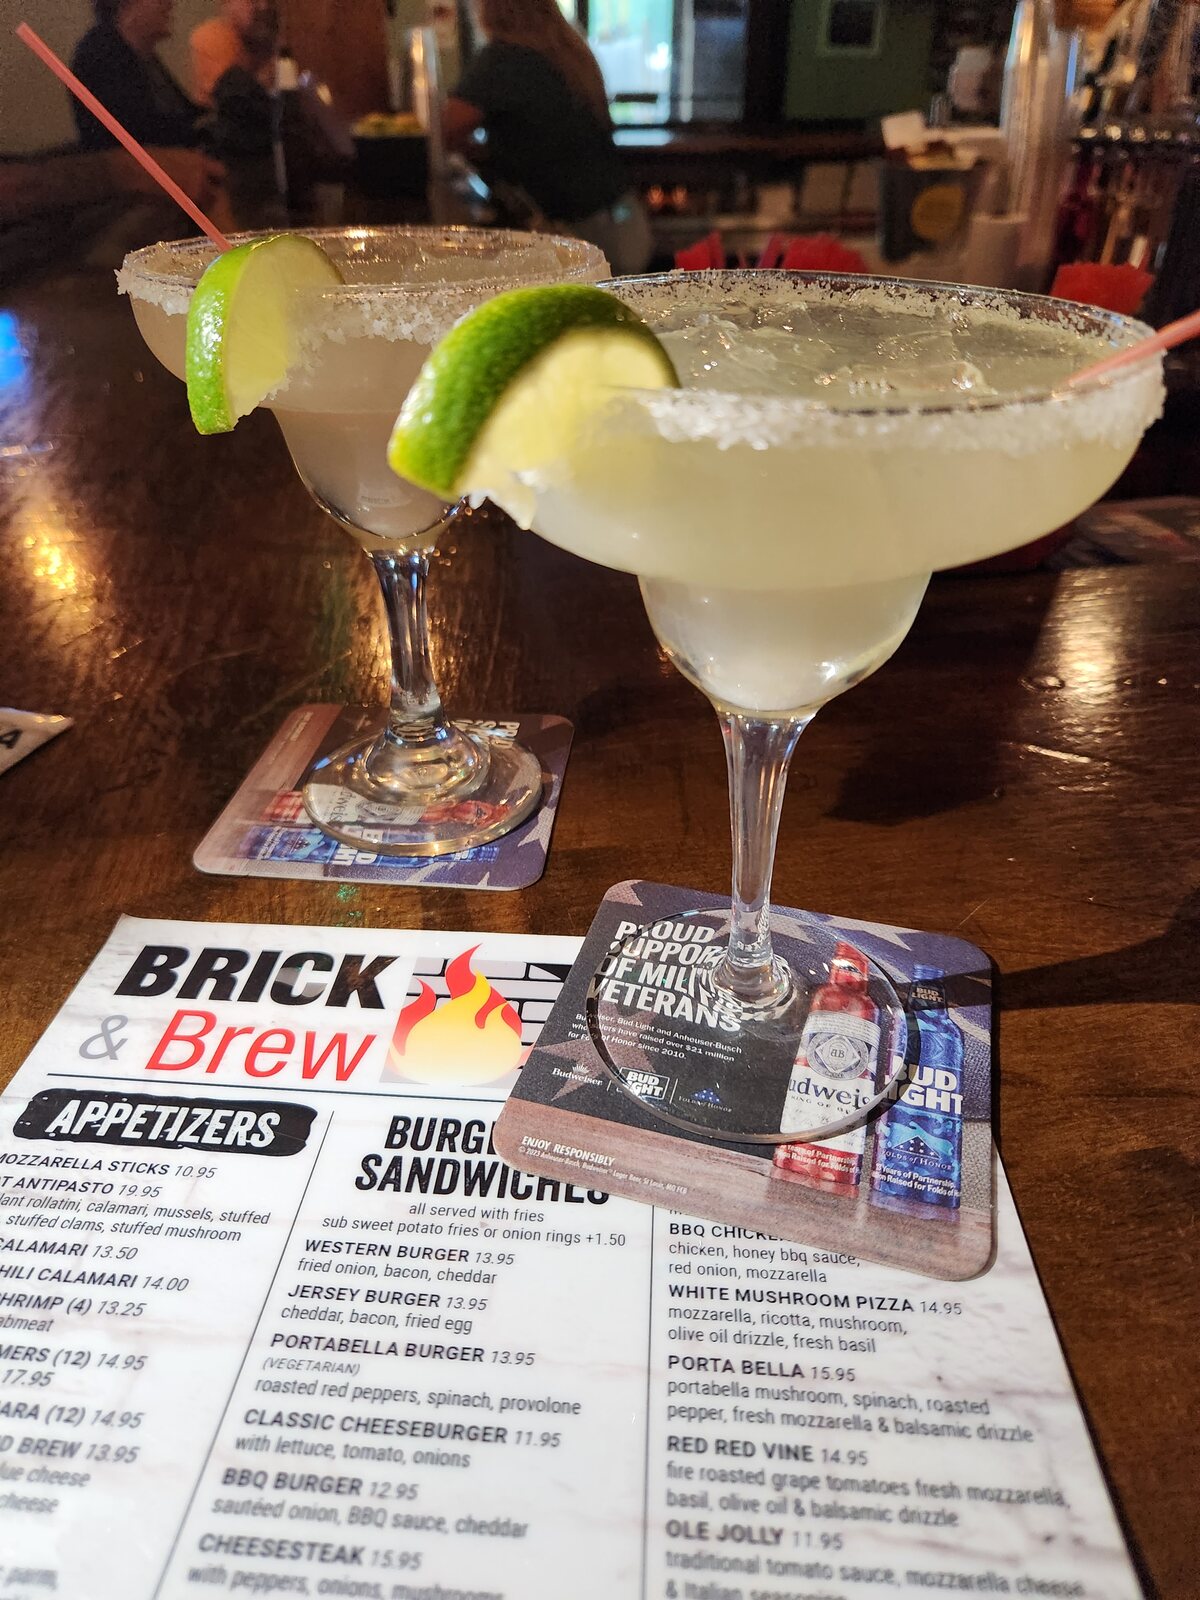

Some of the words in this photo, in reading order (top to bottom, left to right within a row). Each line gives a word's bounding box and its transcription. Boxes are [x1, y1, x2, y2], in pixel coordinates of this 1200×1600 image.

[114, 945, 400, 1009] BRICK
[917, 987, 939, 997] BUD
[78, 1014, 128, 1060] &
[145, 1009, 377, 1082] Brew
[568, 1031, 580, 1040] for
[611, 1035, 636, 1047] Honor
[637, 1043, 660, 1053] since
[661, 1048, 687, 1060] 2010.
[617, 1017, 634, 1027] Bud
[635, 1020, 655, 1032] Light
[656, 1027, 672, 1037] and
[673, 1032, 742, 1054] Anheuser-Busch
[618, 1027, 638, 1038] have
[639, 1032, 665, 1045] raised
[666, 1039, 684, 1049] over
[685, 1045, 703, 1055] $21
[704, 1049, 735, 1062] million
[552, 1067, 603, 1086] Budweiser
[626, 1071, 660, 1086] BUD
[45, 1100, 282, 1148] APPETIZERS
[522, 1136, 551, 1151] ENJOY
[553, 1143, 616, 1166] RESPONSIBLY
[0, 1153, 103, 1171] MOZZARELLA
[108, 1161, 170, 1176] STICKS
[174, 1165, 218, 1179] 10.95
[12, 1177, 114, 1195] ANTIPASTO
[118, 1184, 163, 1198] 19.95
[26, 1195, 82, 1213] rollatini,
[86, 1201, 149, 1218] calamari,
[153, 1206, 214, 1222] mussels,
[219, 1211, 271, 1225] stuffed
[409, 1202, 426, 1216] all
[429, 1204, 476, 1218] served
[480, 1206, 511, 1220] with
[513, 1208, 545, 1222] fries
[5, 1213, 60, 1229] stuffed
[60, 1217, 105, 1234] clams,
[110, 1220, 163, 1237] stuffed
[164, 1224, 242, 1242] mushroom
[322, 1216, 348, 1229] sub
[351, 1219, 394, 1232] sweet
[397, 1220, 444, 1236] potato
[447, 1223, 479, 1238] fries
[483, 1227, 498, 1239] or
[502, 1226, 542, 1241] onion
[545, 1229, 581, 1246] rings
[585, 1232, 627, 1247] +1.50
[669, 1223, 706, 1238] BBQ
[92, 1245, 139, 1260] 13.50
[304, 1239, 392, 1258] WESTERN
[396, 1245, 470, 1263] BURGER
[474, 1251, 515, 1265] 13.95
[668, 1242, 729, 1259] chicken,
[732, 1245, 778, 1263] honey
[780, 1248, 808, 1265] bbq
[812, 1251, 861, 1268] sauce,
[38, 1267, 138, 1288] CALAMARI
[142, 1275, 190, 1291] 14.00
[297, 1258, 331, 1273] fried
[334, 1260, 379, 1278] onion,
[383, 1263, 433, 1281] bacon,
[436, 1267, 497, 1284] cheddar
[668, 1261, 693, 1275] red
[696, 1262, 743, 1280] onion,
[746, 1265, 827, 1283] mozzarella
[66, 1297, 92, 1316] (4)
[97, 1300, 148, 1318] 13.25
[288, 1284, 361, 1303] JERSEY
[364, 1289, 442, 1308] BURGER
[445, 1297, 488, 1312] 13.95
[668, 1284, 730, 1301] WHITE
[735, 1288, 851, 1309] MUSHROOM
[856, 1296, 915, 1312] PIZZA
[919, 1300, 963, 1315] 14.95
[281, 1304, 346, 1323] cheddar,
[349, 1309, 400, 1328] bacon,
[404, 1313, 442, 1330] fried
[444, 1318, 473, 1335] egg
[668, 1305, 757, 1325] mozzarella,
[760, 1309, 815, 1328] ricotta,
[819, 1315, 909, 1335] mushroom,
[270, 1333, 399, 1357] PORTABELLA
[404, 1343, 485, 1363] BURGER
[490, 1350, 535, 1367] 13.95
[668, 1326, 705, 1342] olive
[709, 1328, 728, 1344] oil
[732, 1330, 789, 1349] drizzle,
[793, 1333, 834, 1351] fresh
[838, 1336, 877, 1354] basil
[52, 1348, 91, 1369] (12)
[96, 1353, 149, 1371] 14.95
[261, 1356, 361, 1377] (VEGETARIAN)
[667, 1354, 736, 1374] PORTA
[741, 1359, 806, 1379] BELLA
[811, 1365, 856, 1382] 15.95
[2, 1369, 55, 1387] 17.95
[255, 1377, 317, 1397] roasted
[320, 1381, 348, 1399] red
[351, 1384, 421, 1406] peppers,
[426, 1387, 494, 1411] spinach,
[498, 1392, 582, 1415] provolone
[667, 1379, 750, 1398] portabella
[754, 1382, 848, 1407] mushroom,
[853, 1391, 922, 1413] spinach,
[926, 1396, 990, 1416] roasted
[45, 1404, 86, 1427] (12)
[91, 1409, 146, 1429] 14.95
[243, 1409, 336, 1432] CLASSIC
[340, 1415, 509, 1445] CHEESEBURGER
[513, 1429, 562, 1448] 11.95
[667, 1402, 727, 1424] pepper,
[732, 1405, 777, 1425] fresh
[780, 1409, 873, 1432] mozzarella
[877, 1416, 890, 1434] &
[894, 1416, 973, 1439] balsamic
[976, 1421, 1034, 1443] drizzle
[17, 1437, 83, 1458] BREW
[85, 1442, 141, 1464] 13.95
[235, 1434, 271, 1452] with
[274, 1436, 337, 1459] lettuce,
[342, 1442, 407, 1465] tomato,
[413, 1447, 471, 1468] onions
[666, 1435, 709, 1455] RED
[714, 1438, 757, 1459] RED
[762, 1441, 815, 1463] VINE
[820, 1447, 868, 1467] 14.95
[220, 1467, 270, 1489] BBQ
[273, 1472, 364, 1496] BURGER
[368, 1481, 420, 1501] 12.95
[666, 1460, 695, 1479] fire
[698, 1463, 766, 1486] roasted
[771, 1470, 821, 1492] grape
[825, 1473, 911, 1497] tomatoes
[914, 1477, 961, 1500] fresh
[665, 1519, 710, 1542] OLE
[715, 1522, 785, 1546] JOLLY
[197, 1531, 367, 1567] CHEESESTEAK
